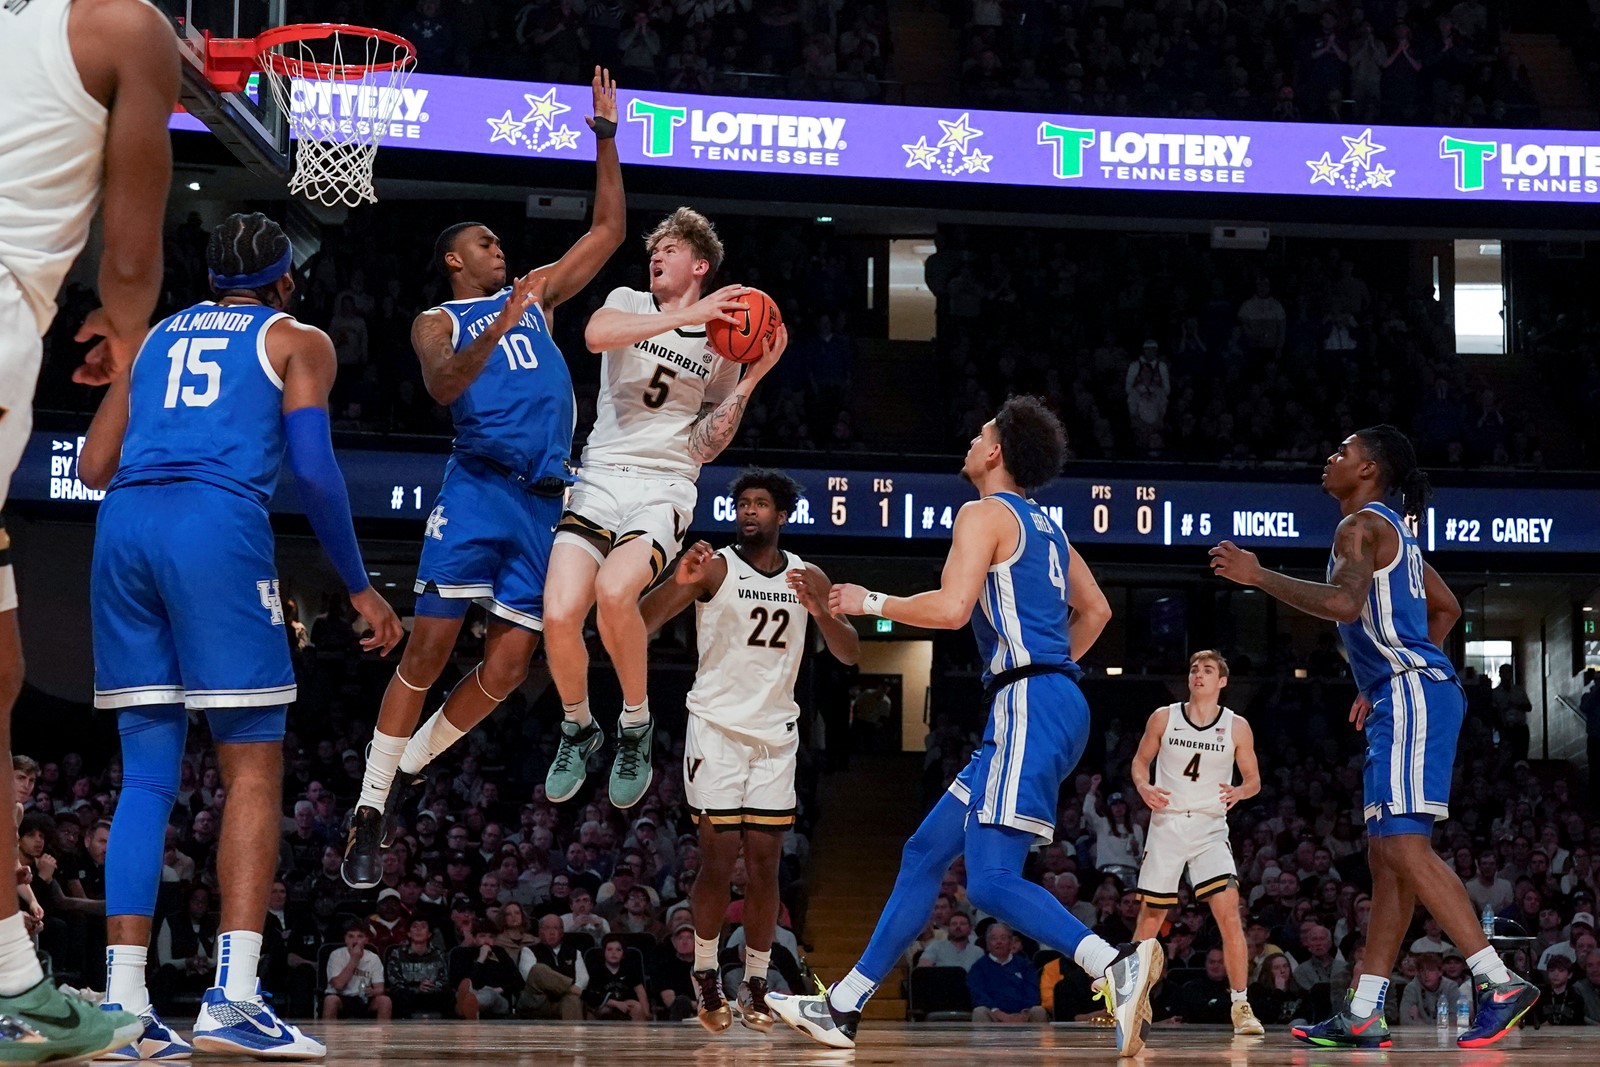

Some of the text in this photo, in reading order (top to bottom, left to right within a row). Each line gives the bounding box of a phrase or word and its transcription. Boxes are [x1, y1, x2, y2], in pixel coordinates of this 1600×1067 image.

[290, 80, 428, 121] OTTERY
[691, 110, 846, 150] LOTTERY
[691, 146, 840, 166] TENNESSEE
[1100, 131, 1251, 167] LOTTERY
[1501, 143, 1600, 177] LOTTE
[1100, 166, 1245, 183] TENNESSEE
[165, 311, 254, 332] ALMONOR
[498, 333, 539, 371] 10
[634, 340, 710, 380] VANDERBILT
[163, 337, 230, 408] 15
[642, 363, 678, 410] 5
[51, 455, 73, 477] BY
[828, 477, 894, 493] PTS FLS
[1092, 485, 1156, 501] PTS FLS
[831, 496, 847, 527] 5
[879, 497, 889, 528] 1
[1093, 504, 1109, 534] 0
[1137, 505, 1152, 535] 0
[1233, 510, 1300, 537] NICKEL
[1445, 517, 1553, 543] #22 CAREY
[1048, 540, 1066, 601] 4
[738, 588, 801, 605] VANDERBIL
[747, 606, 790, 649] 22
[1168, 737, 1226, 752] VANDERBILT
[1182, 752, 1202, 782] 4
